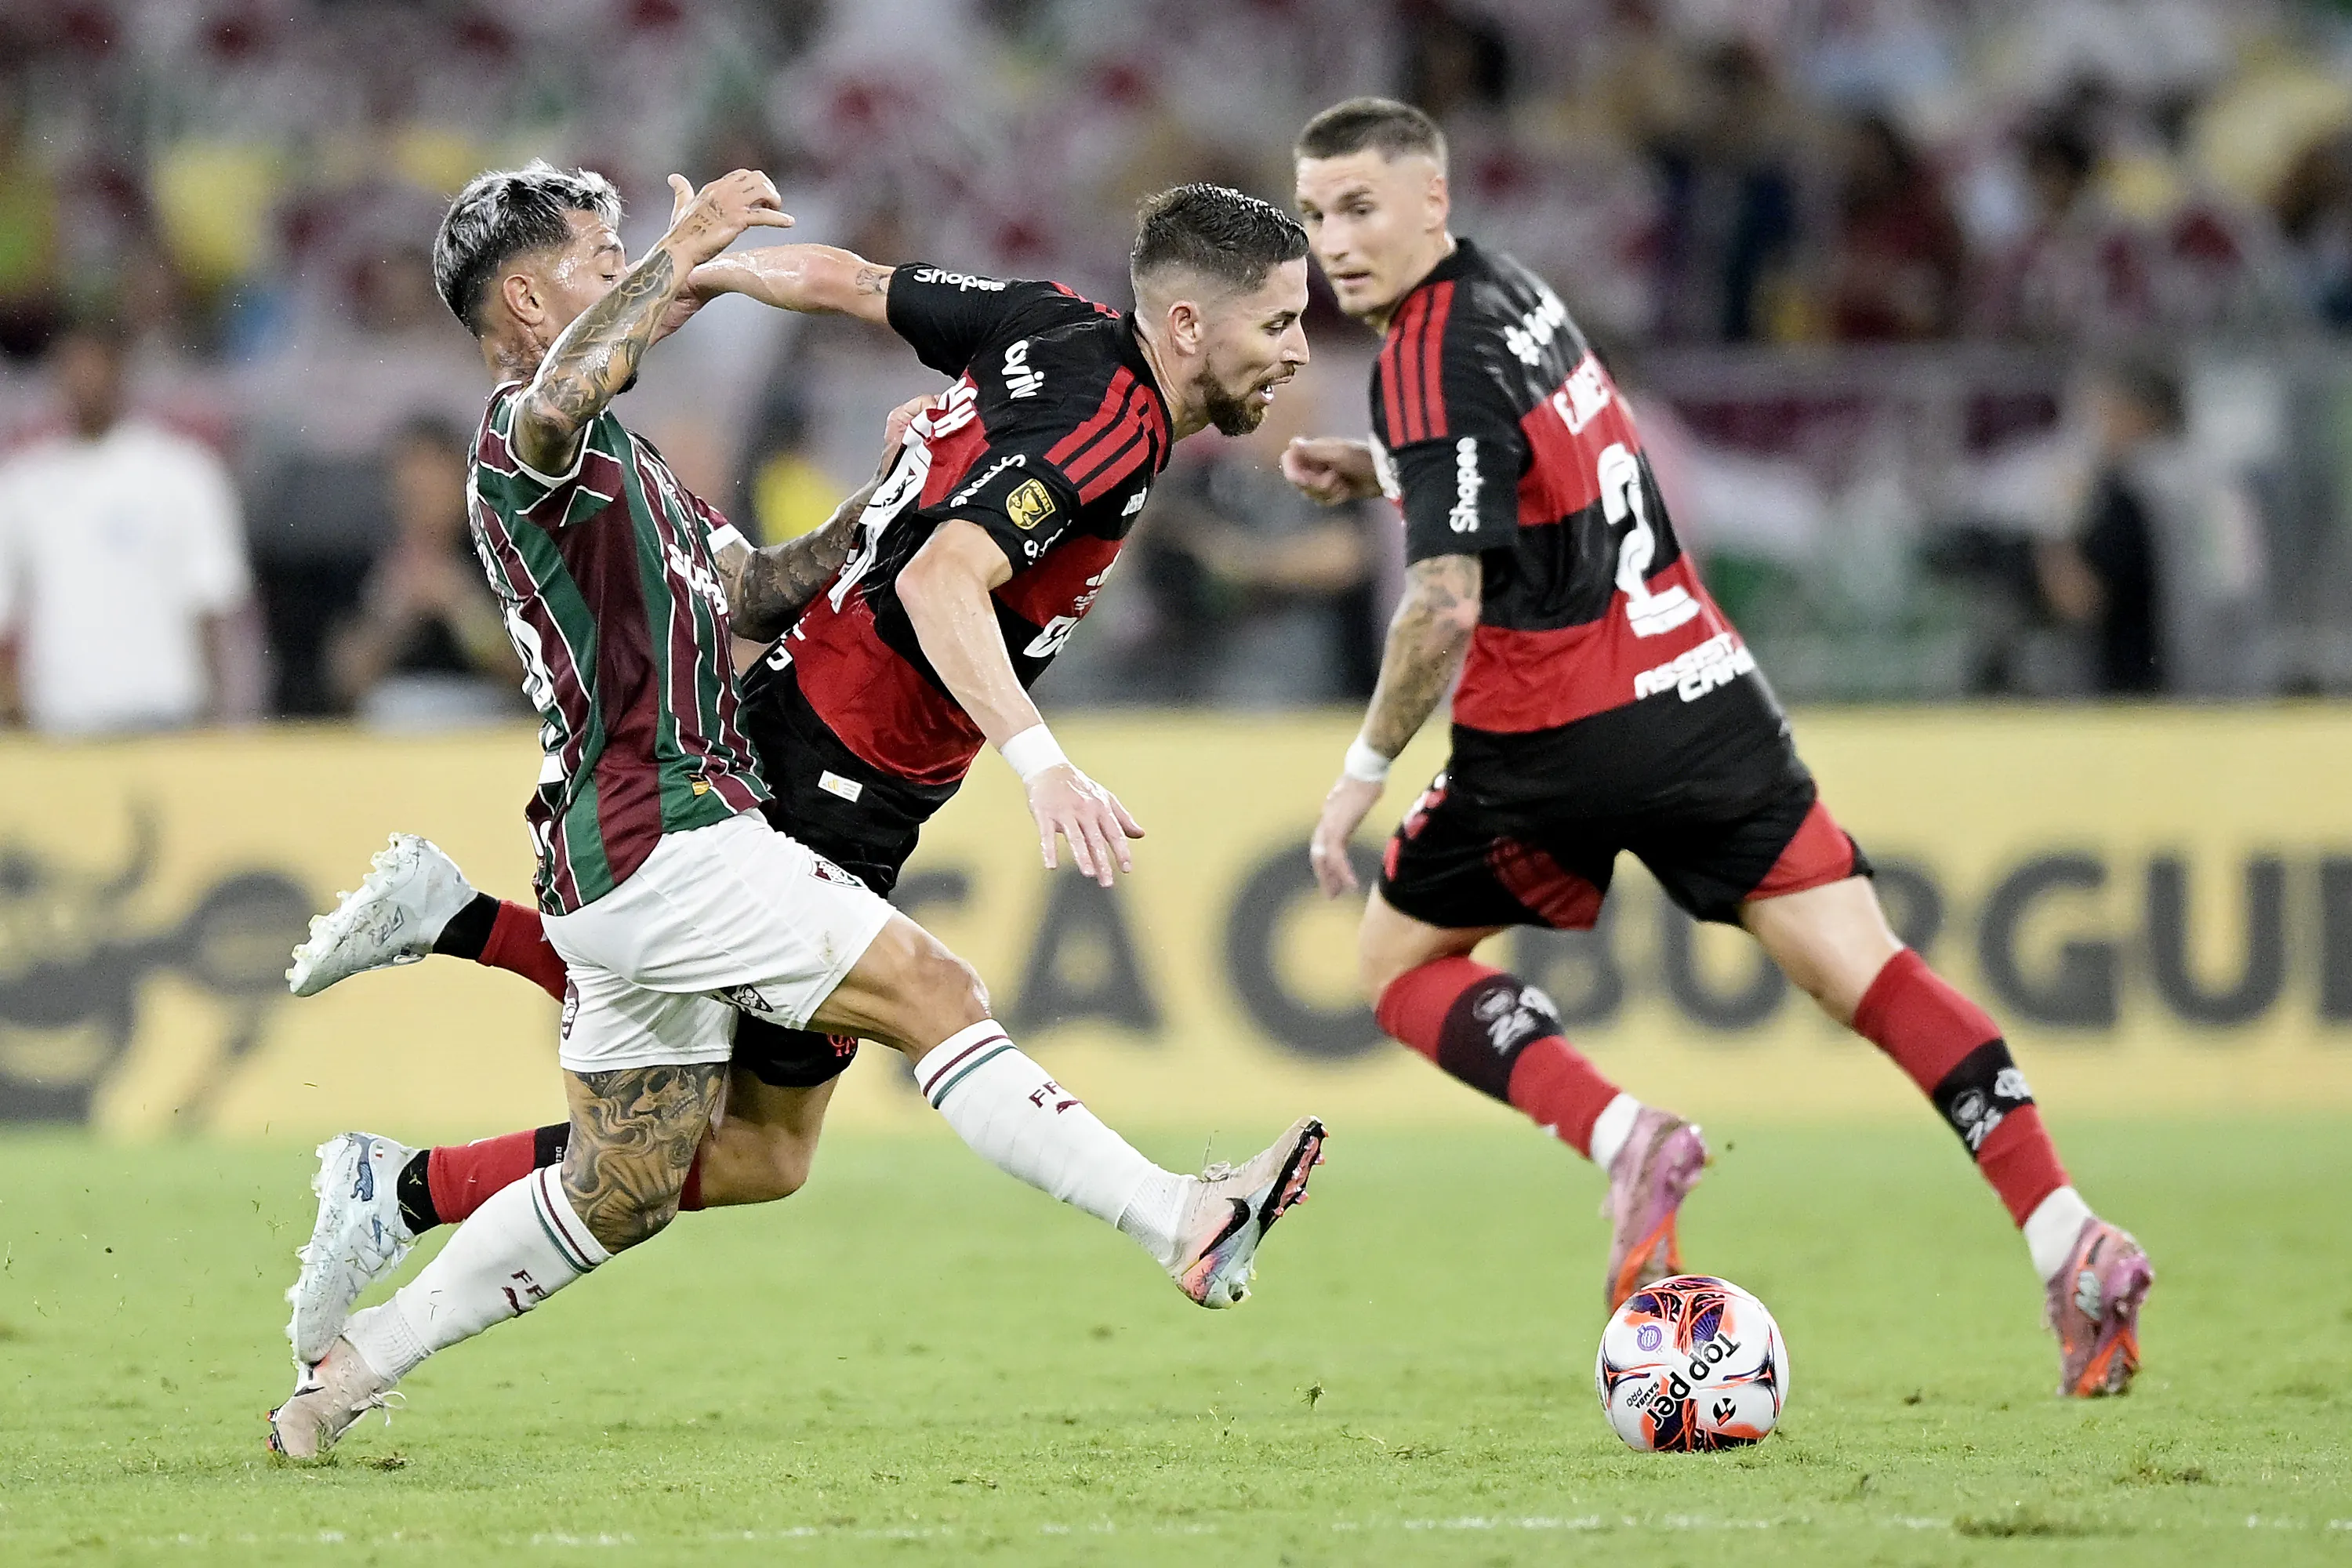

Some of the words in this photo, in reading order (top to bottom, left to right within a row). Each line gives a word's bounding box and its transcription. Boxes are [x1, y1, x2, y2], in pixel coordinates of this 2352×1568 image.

[913, 267, 1006, 292] Shopee
[1450, 437, 1486, 533] Shopee
[1635, 1381, 1660, 1410] SAMBA
[1647, 1333, 1741, 1429] Topper
[1626, 1386, 1643, 1408] PRO
